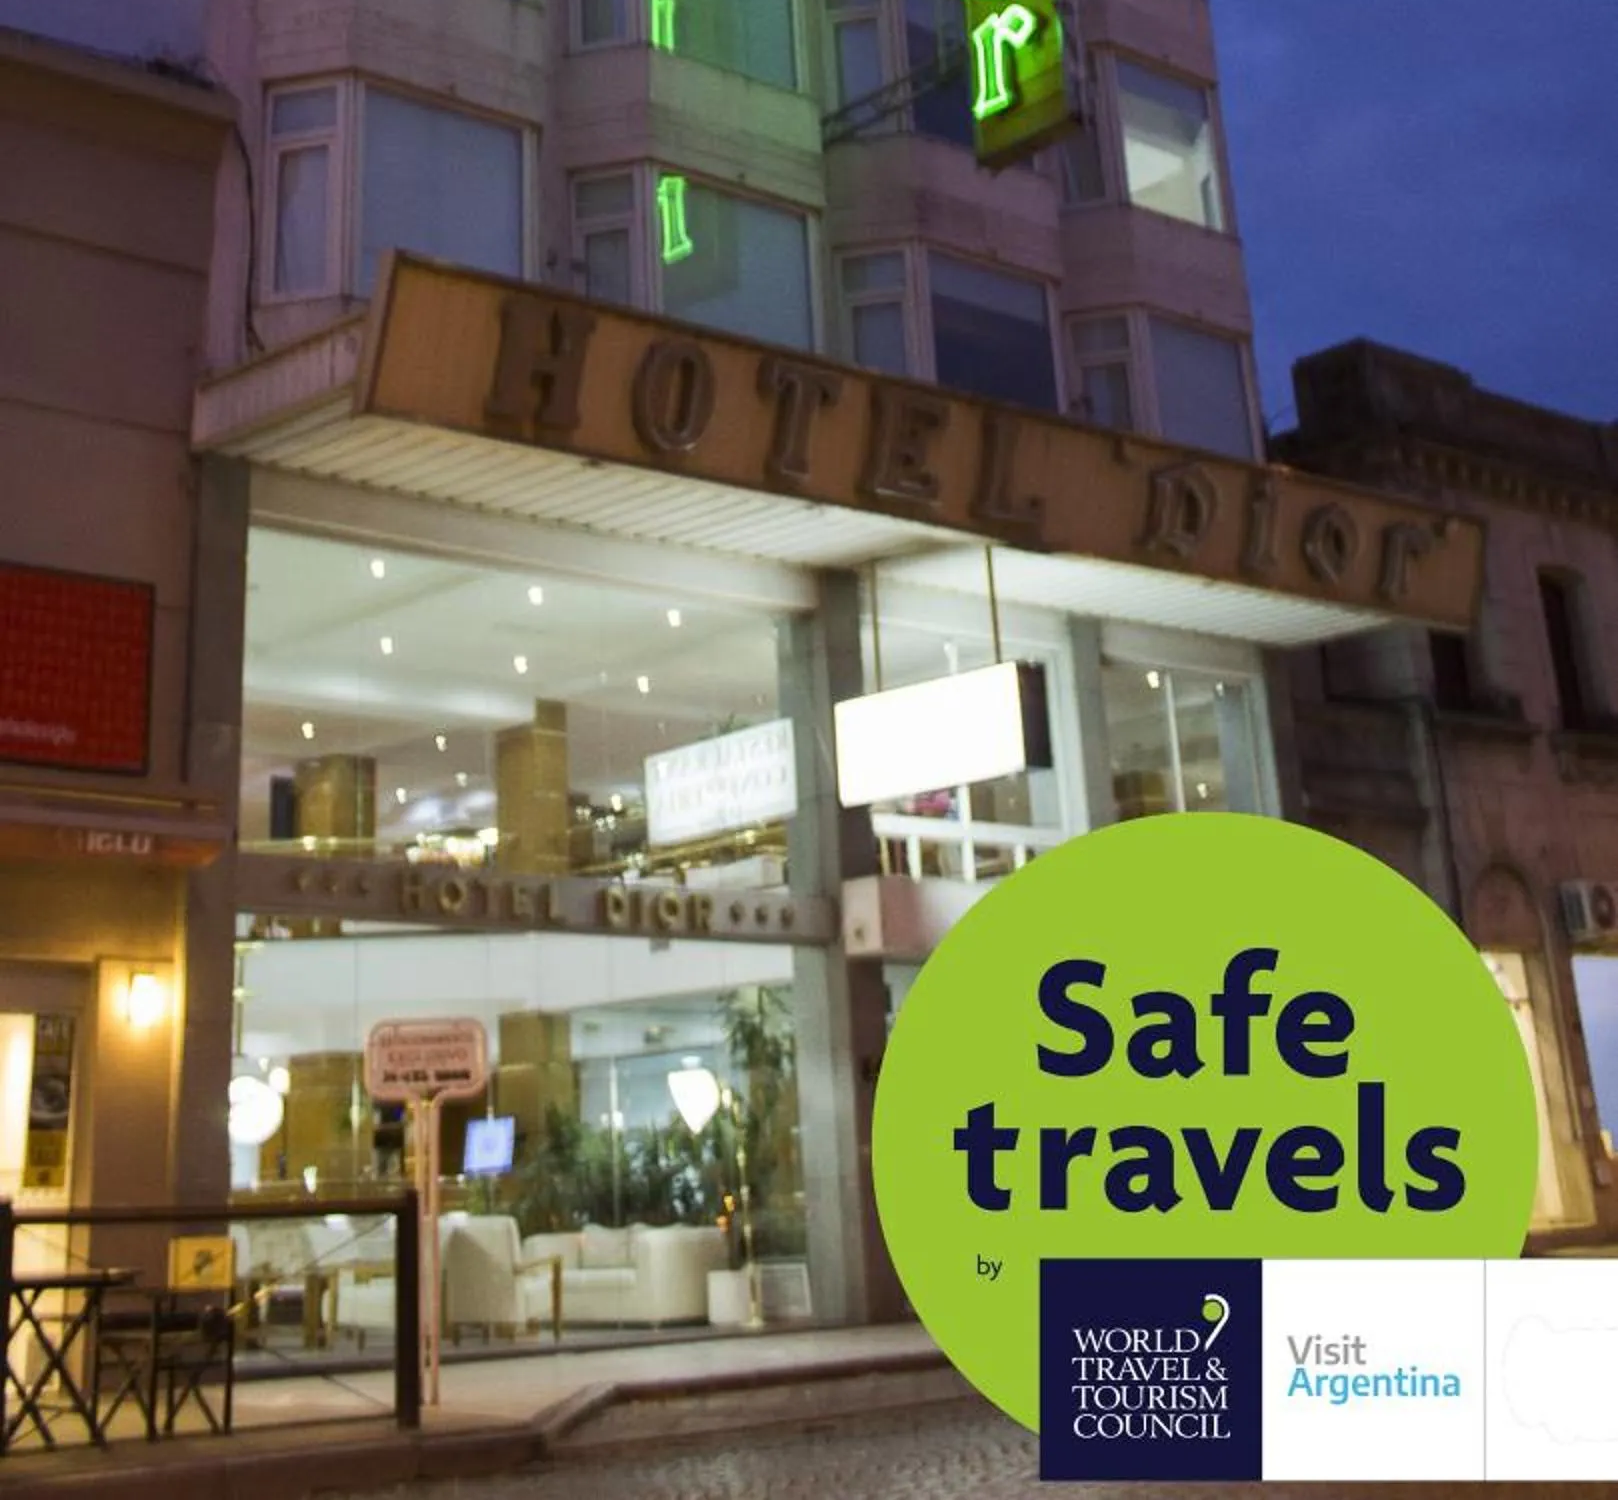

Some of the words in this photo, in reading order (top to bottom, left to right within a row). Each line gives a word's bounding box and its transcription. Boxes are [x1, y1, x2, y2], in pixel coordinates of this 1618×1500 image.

[487, 295, 1048, 536] HOTEL
[394, 868, 564, 926] HOTEL
[596, 884, 713, 936] DIOR
